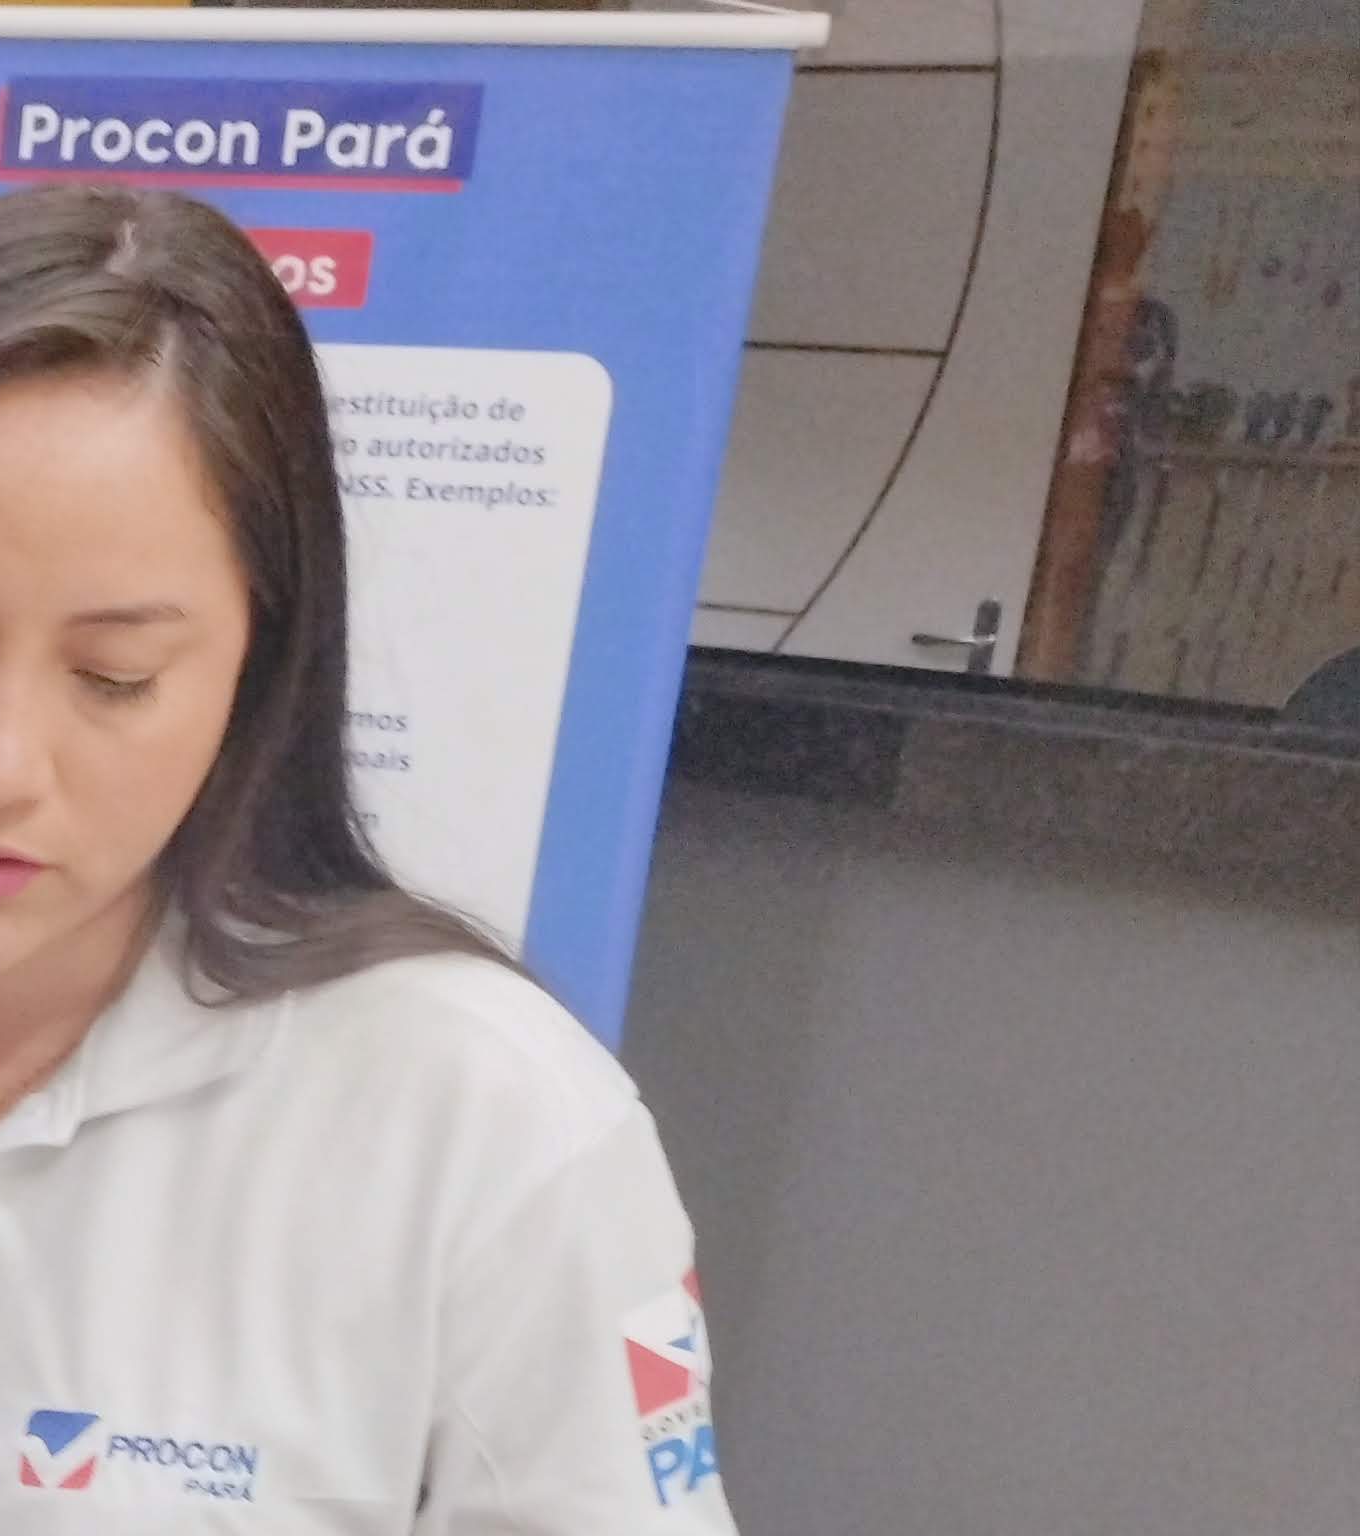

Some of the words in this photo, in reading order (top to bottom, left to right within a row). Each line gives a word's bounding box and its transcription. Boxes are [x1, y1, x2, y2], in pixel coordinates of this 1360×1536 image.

[18, 103, 261, 166] Procon
[281, 108, 454, 170] Pará
[272, 255, 337, 296] os
[486, 397, 527, 423] de
[365, 436, 546, 466] autorizados
[403, 476, 559, 511] Exemplos:
[106, 1434, 258, 1476] PROCON
